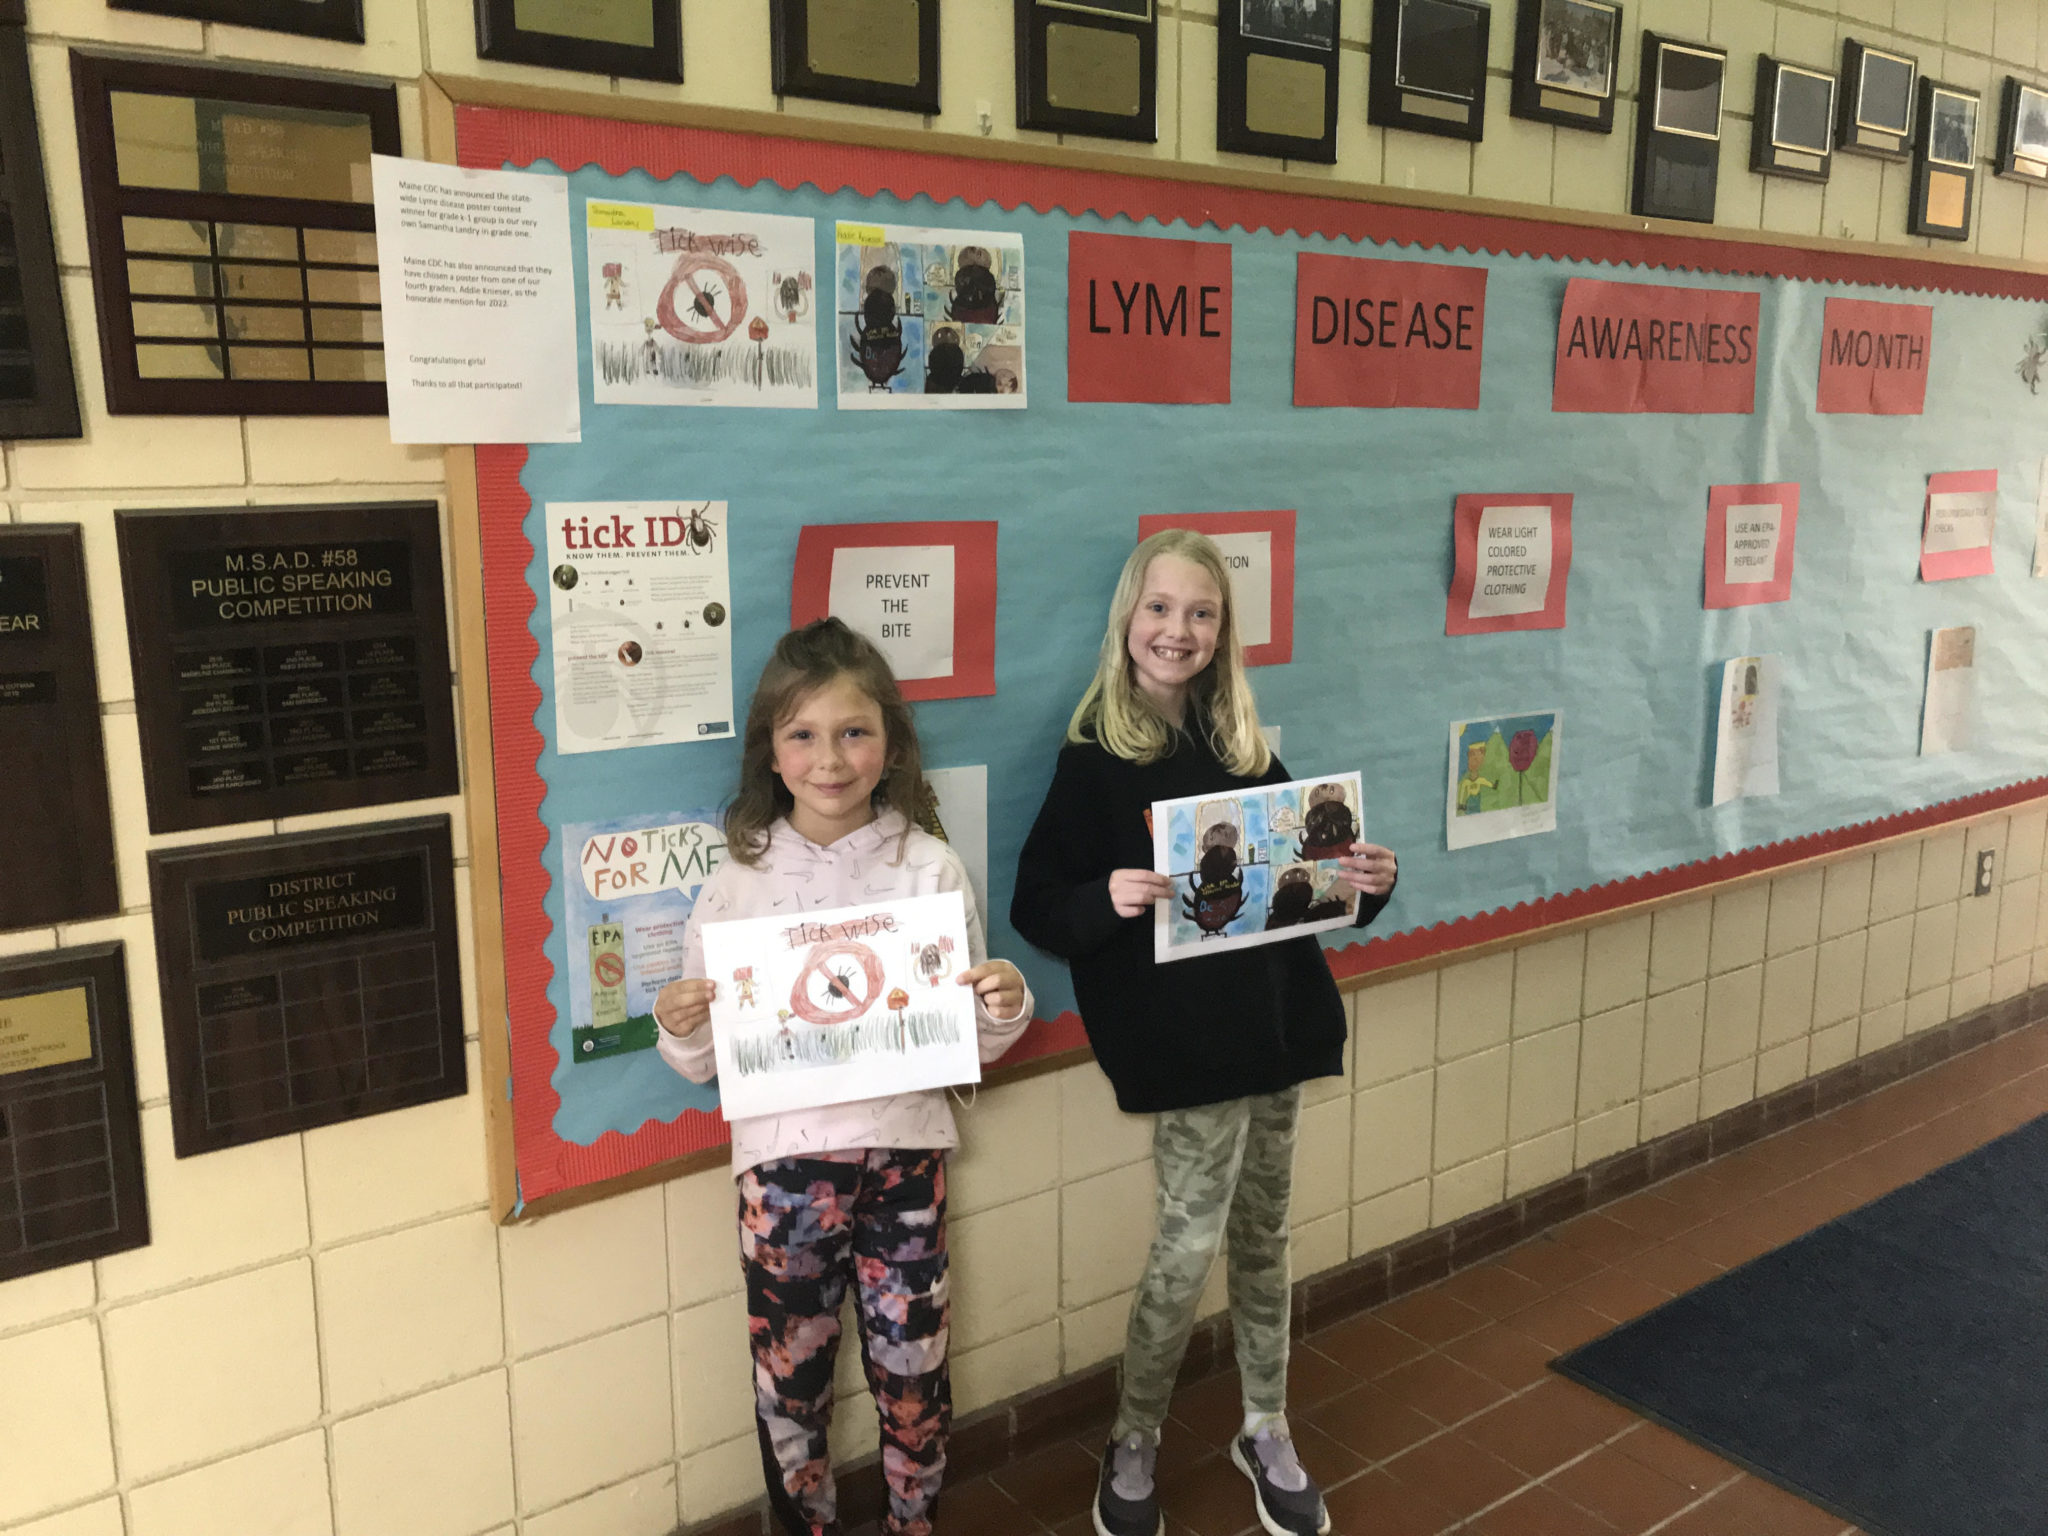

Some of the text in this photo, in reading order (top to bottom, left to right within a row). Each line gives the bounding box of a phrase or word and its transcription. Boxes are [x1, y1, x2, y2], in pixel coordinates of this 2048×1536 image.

[399, 181, 422, 191] Maine
[424, 184, 438, 193] CDC
[440, 185, 451, 195] has
[454, 189, 495, 200] announced
[497, 192, 509, 200] the
[400, 194, 522, 213] wide Lyme disease poster contest
[400, 207, 425, 217] winner
[427, 208, 437, 218] for
[439, 211, 459, 222] grade
[473, 215, 497, 225] group
[521, 219, 538, 228] very
[401, 220, 417, 228] own
[419, 221, 453, 233] Samantha
[455, 225, 480, 236] Landry
[491, 229, 512, 237] grade
[403, 256, 552, 276] Maine CDC has also announced that they
[404, 269, 422, 278] have
[423, 271, 448, 280] chosen
[456, 274, 479, 283] poster
[481, 275, 499, 284] from
[518, 277, 526, 285] of
[405, 281, 427, 291] fourth
[459, 286, 480, 294] Addie
[525, 288, 538, 297] the
[406, 294, 442, 304] honorable
[444, 296, 474, 306] mention
[476, 298, 487, 307] for
[1089, 278, 1221, 338] LYME
[1312, 295, 1474, 351] DISEASE
[1567, 314, 1753, 365] AWARENESS
[1829, 328, 1924, 370] MONTH
[410, 354, 466, 366] Congratulations
[412, 379, 522, 391] Thanks to all that participated!
[562, 515, 686, 550] tick ID
[1488, 527, 1538, 539] WEAR LIGHT
[1734, 522, 1748, 534] USE
[1750, 523, 1760, 533] AN
[225, 549, 358, 572] M.S.A.D. #58
[566, 549, 690, 560] KNOW THEM. PREVENT THEM.
[1487, 546, 1527, 558] COLORED
[1486, 564, 1537, 577] PROTECTIVE
[191, 570, 393, 598] PUBLIC SPEAKING
[866, 574, 930, 589] PREVENT
[1483, 583, 1527, 596] CLOTHING
[218, 593, 373, 620] COMPETITION
[881, 599, 909, 613] THE
[881, 623, 912, 638] BITE
[584, 836, 638, 865] NO
[268, 872, 356, 898] DISTRICT
[594, 861, 649, 897] FOR
[227, 887, 396, 925] PUBLIC SPEAKING
[248, 910, 380, 943] COMPETITION
[592, 929, 621, 946] EPA
